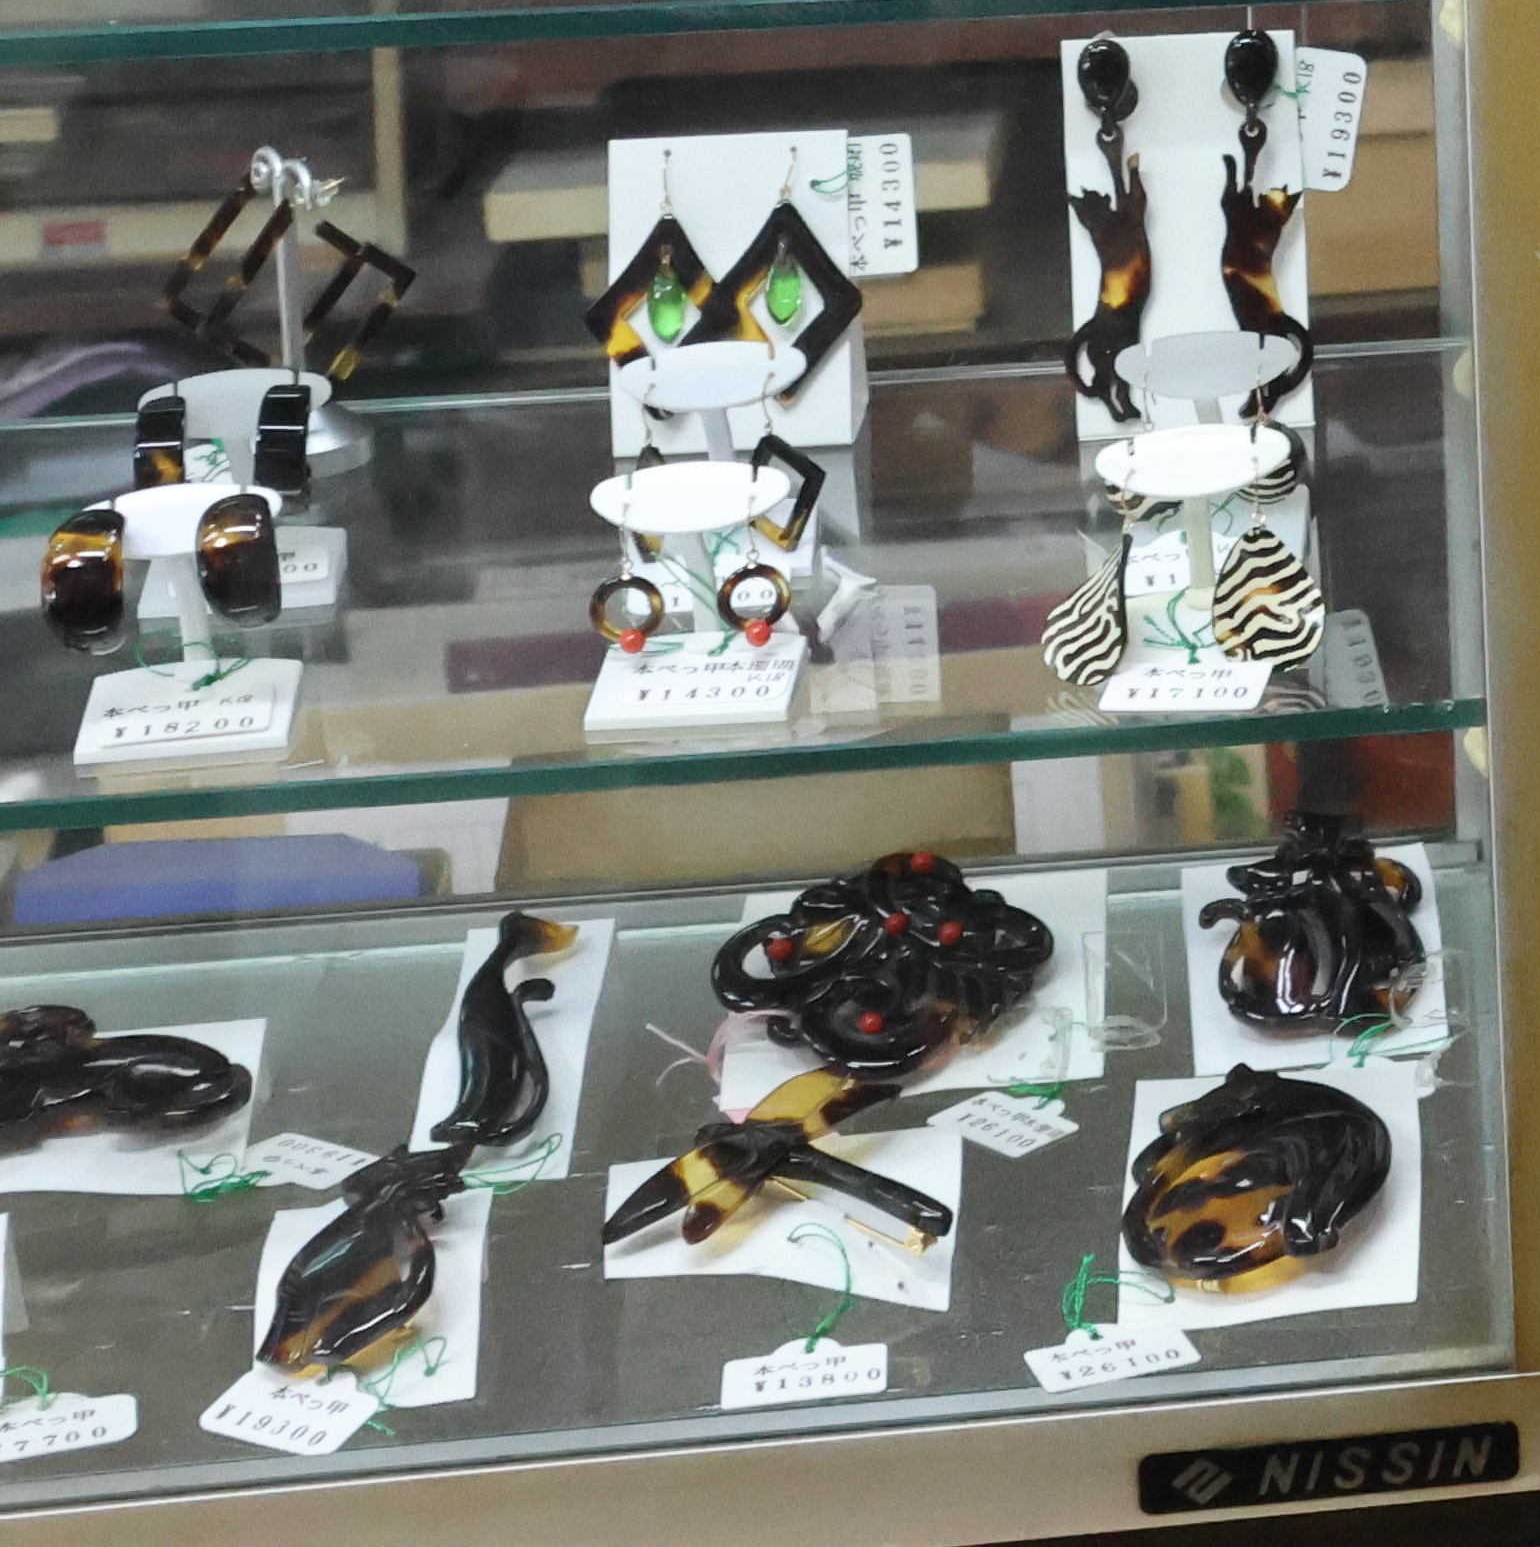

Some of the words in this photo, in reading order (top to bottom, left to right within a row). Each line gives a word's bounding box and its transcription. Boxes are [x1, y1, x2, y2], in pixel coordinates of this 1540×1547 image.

[1321, 70, 1363, 179] ¥19300
[878, 142, 903, 250] ¥14300
[637, 684, 771, 701] ¥14300
[1126, 685, 1250, 700] ¥17100
[114, 716, 254, 739] ¥18200
[753, 1355, 847, 1376] 本べっ甲
[1059, 1348, 1181, 1381] ¥26100
[754, 1367, 882, 1393] ¥13800
[214, 1403, 328, 1447] ¥19300
[1258, 1435, 1493, 1496] NISSIN
